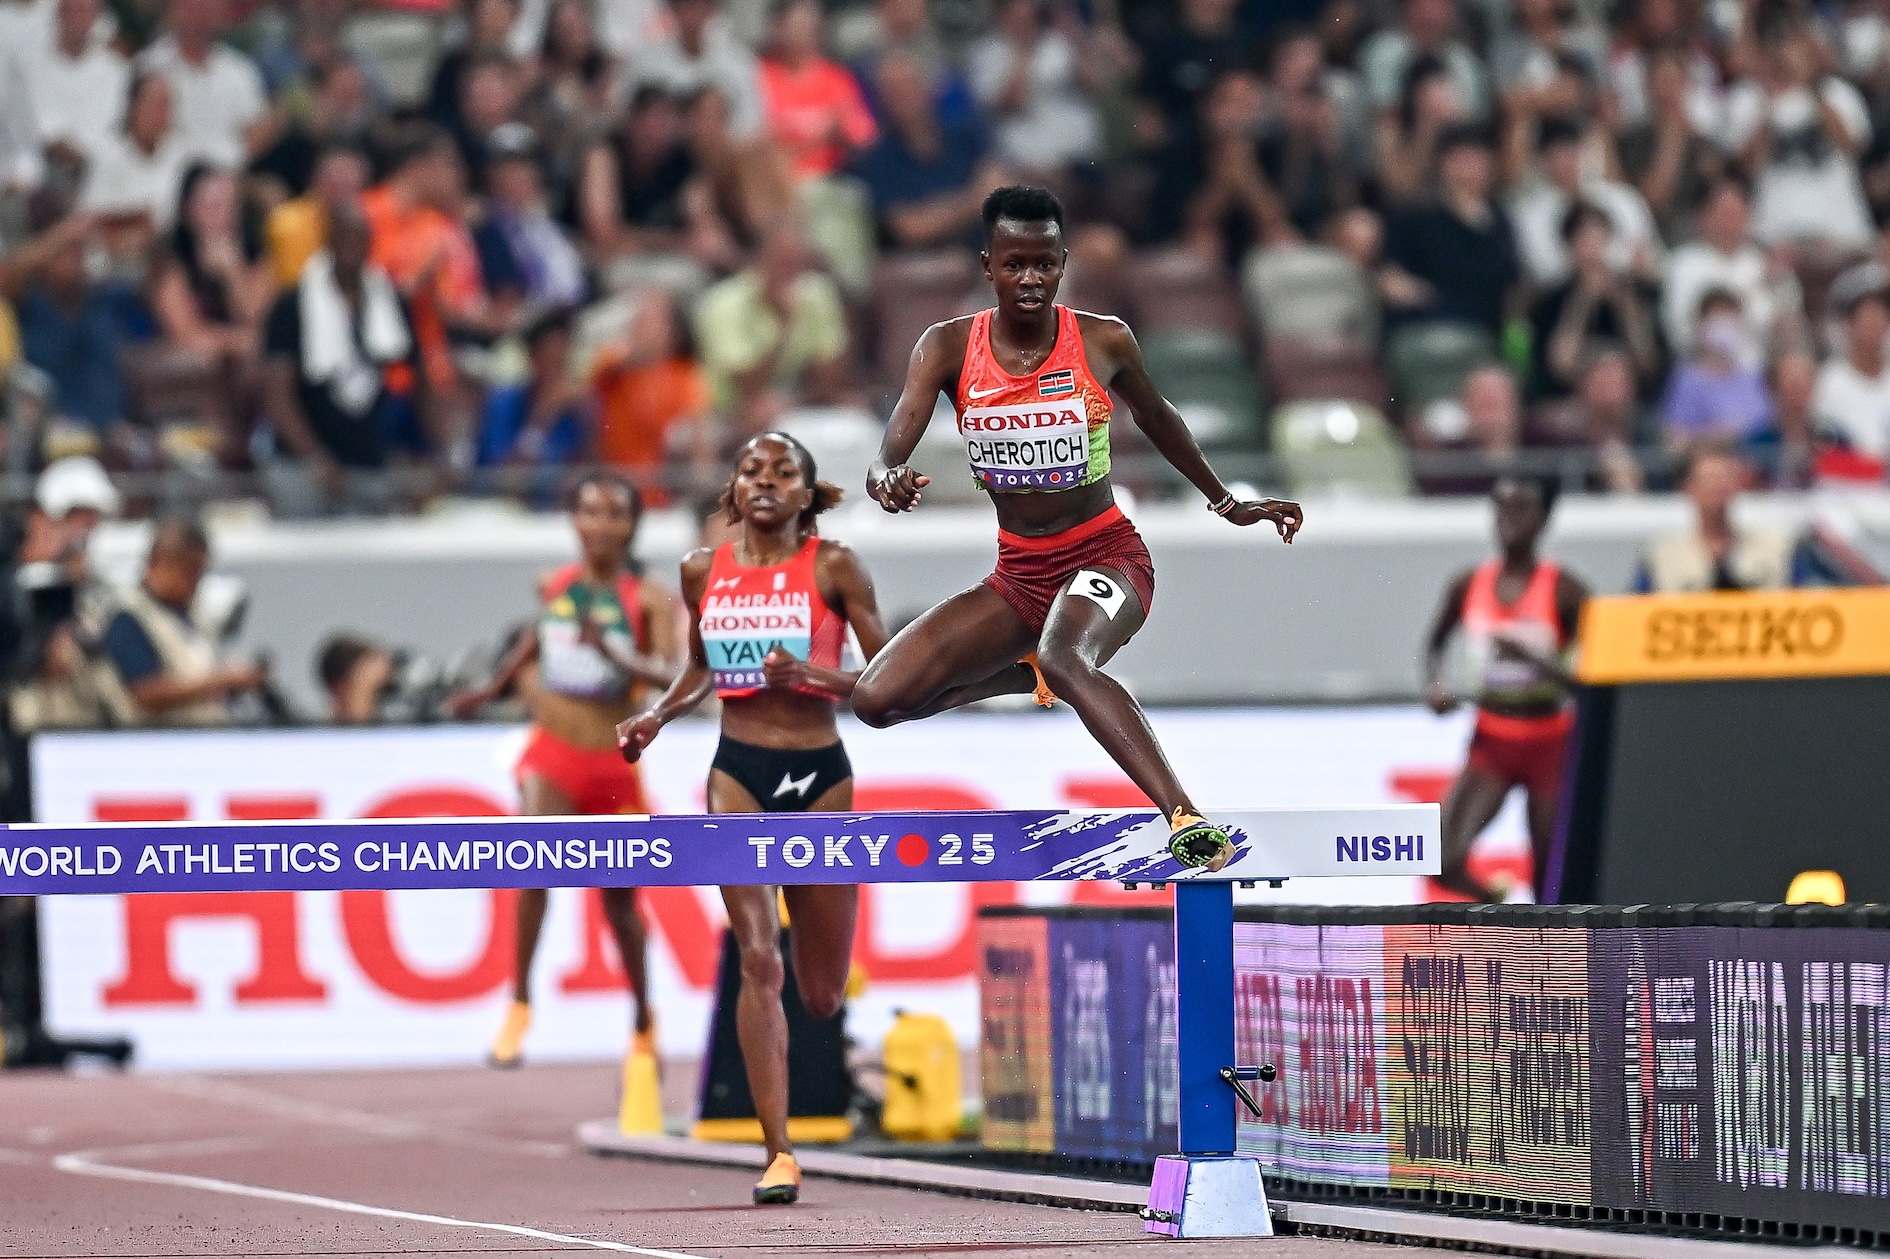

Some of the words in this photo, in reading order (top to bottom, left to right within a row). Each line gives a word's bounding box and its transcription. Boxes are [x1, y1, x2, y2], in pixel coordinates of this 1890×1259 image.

[963, 410, 1083, 431] HONDA
[968, 435, 1084, 466] CHEROTICH
[706, 591, 810, 608] BAHRAIN
[1088, 578, 1113, 598] 9
[704, 614, 806, 631] HONDA
[1646, 604, 1846, 662] SEIKO
[720, 639, 783, 664] YAV
[0, 846, 122, 877] WORLD
[136, 842, 341, 874] ATHLETICS
[354, 838, 673, 872] CHAMPIONSHIPS
[1336, 835, 1424, 862] NISHI
[1296, 972, 1382, 1135] HONDA
[1403, 953, 1469, 1164] SEIKO
[1709, 959, 1790, 1190] WORLD
